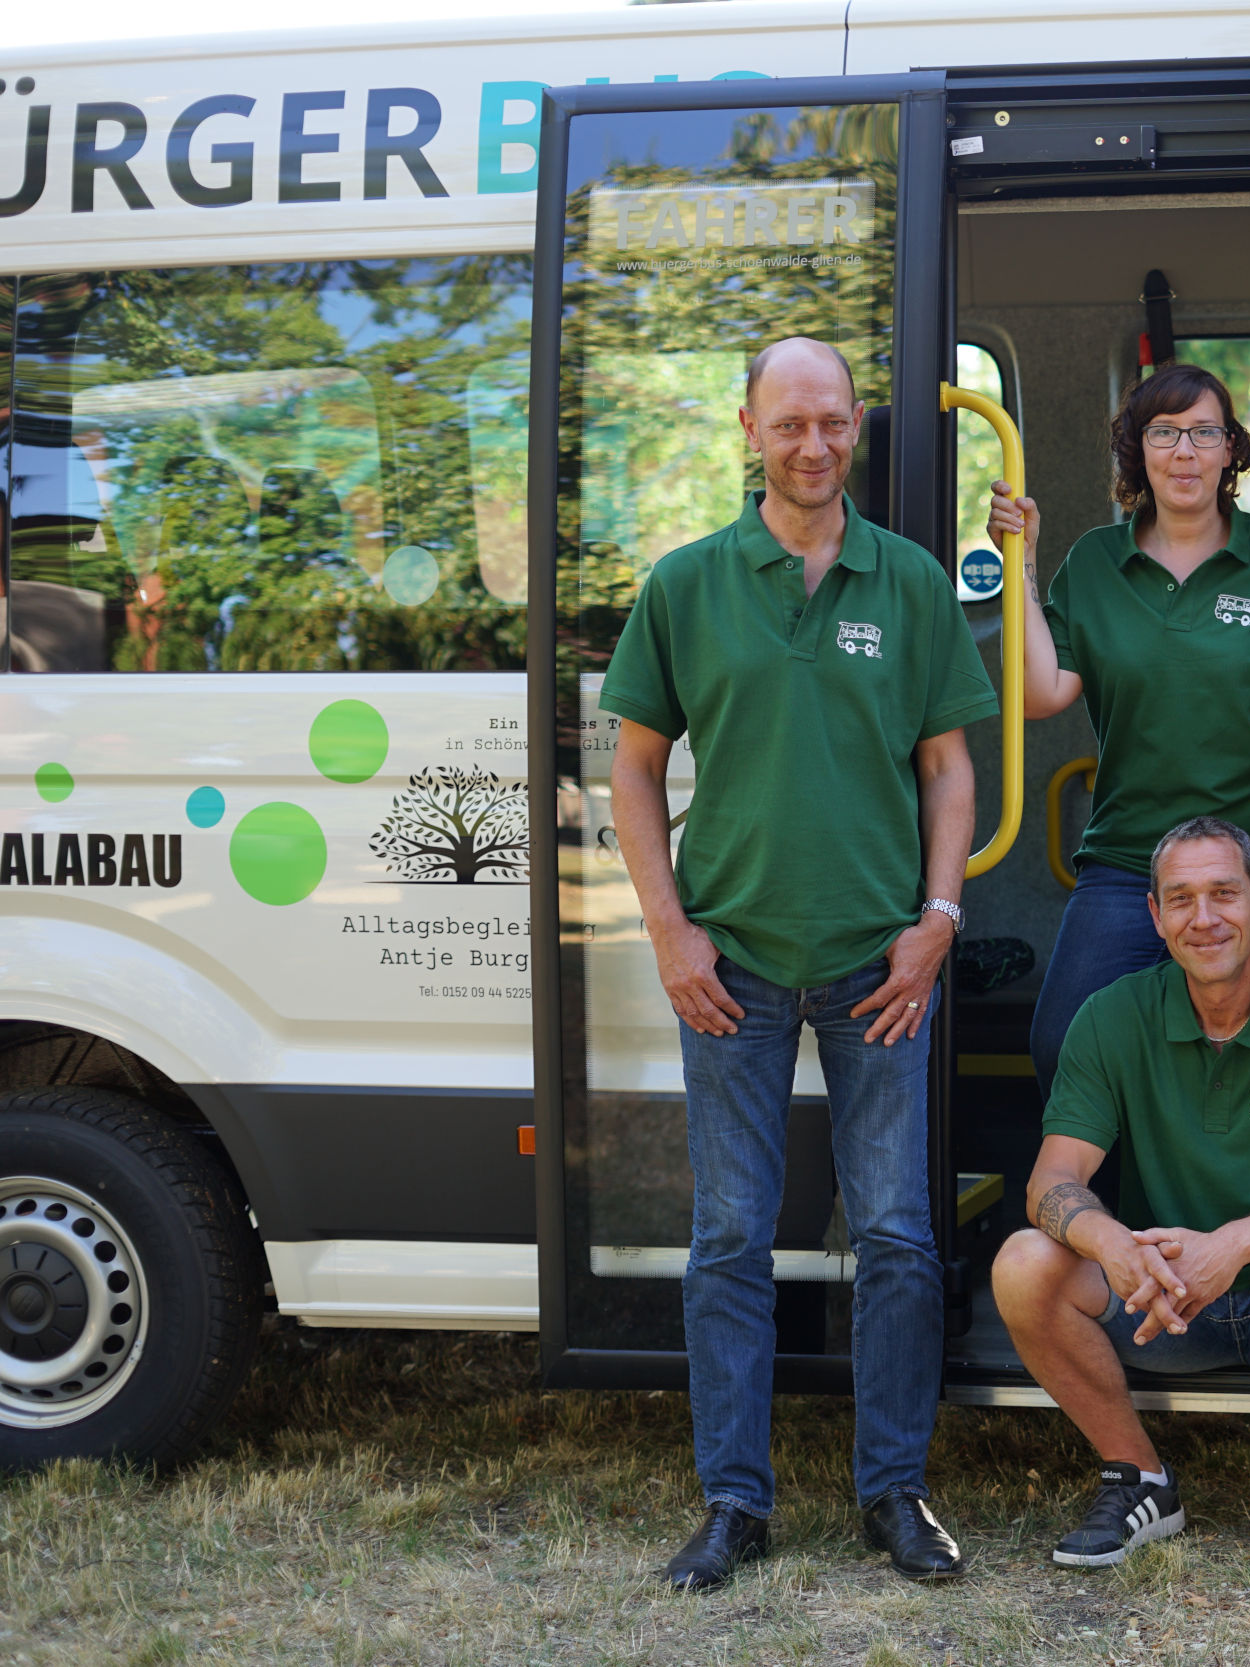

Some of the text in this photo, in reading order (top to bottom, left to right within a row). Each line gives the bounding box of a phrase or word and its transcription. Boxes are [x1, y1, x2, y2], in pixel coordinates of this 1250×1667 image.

[616, 196, 860, 250] FAHRER
[617, 254, 862, 272] www.buergerbus-schoenwalde-glien.de
[489, 717, 519, 729] Ein
[445, 737, 464, 750] in
[380, 948, 454, 970] Antje
[419, 986, 532, 1000] Tel.: 0152 09 44 5225
